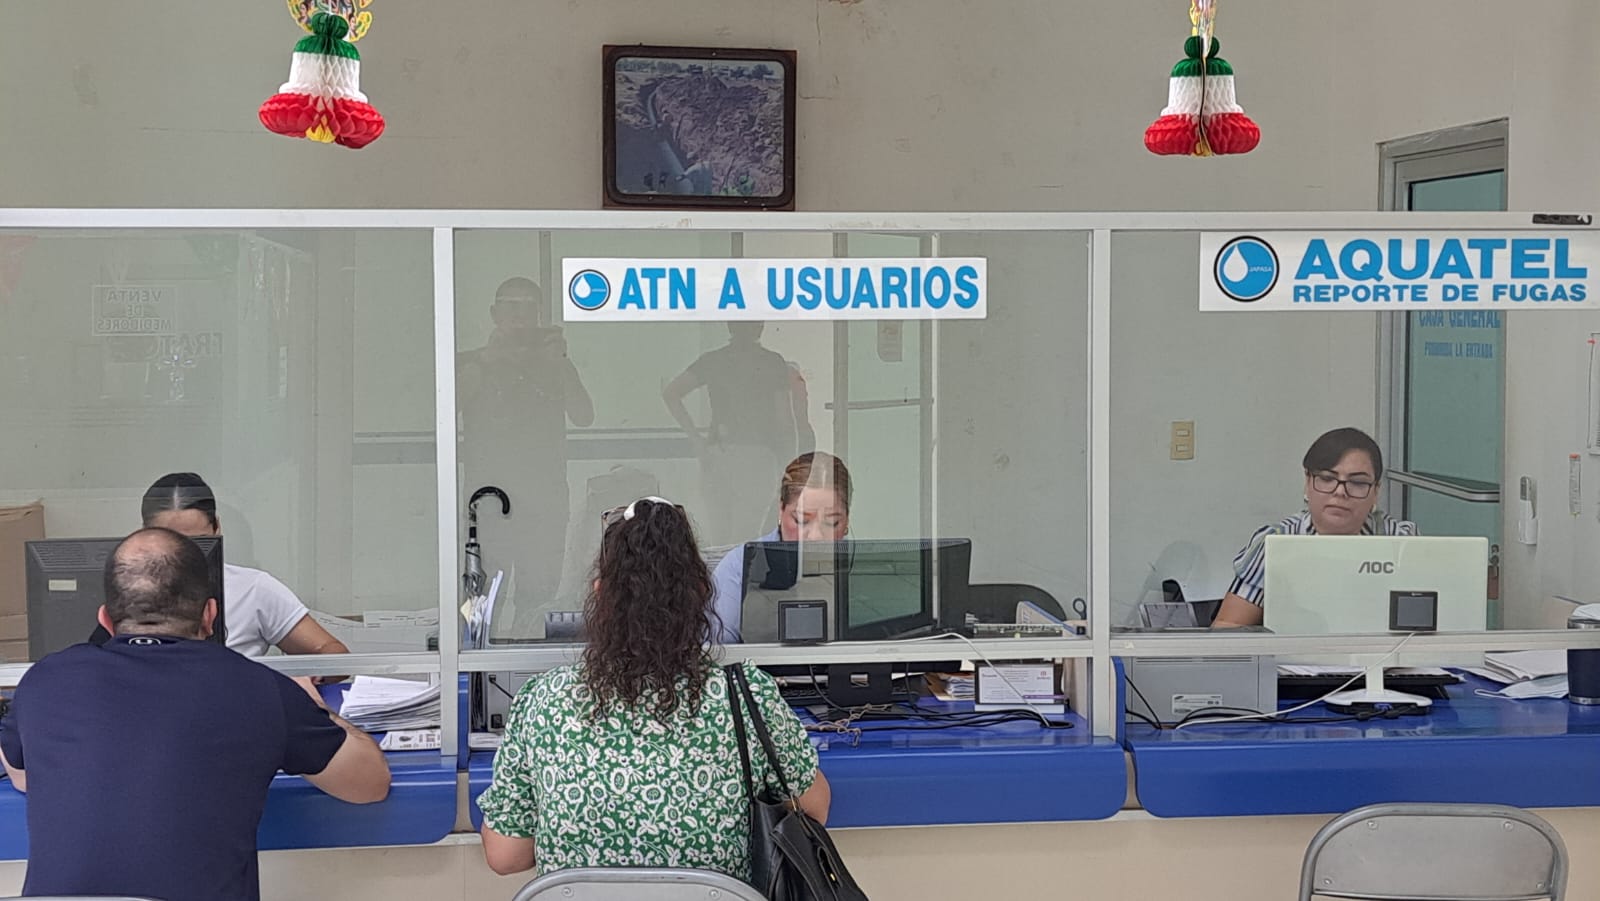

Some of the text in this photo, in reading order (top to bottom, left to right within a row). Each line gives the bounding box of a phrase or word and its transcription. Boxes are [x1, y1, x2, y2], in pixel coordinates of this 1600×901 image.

[1294, 238, 1587, 281] AQUATEL
[618, 266, 979, 310] ATN A USUARIOS
[1293, 283, 1587, 302] REPORTE DE FUGAS
[1358, 561, 1394, 574] AOC
